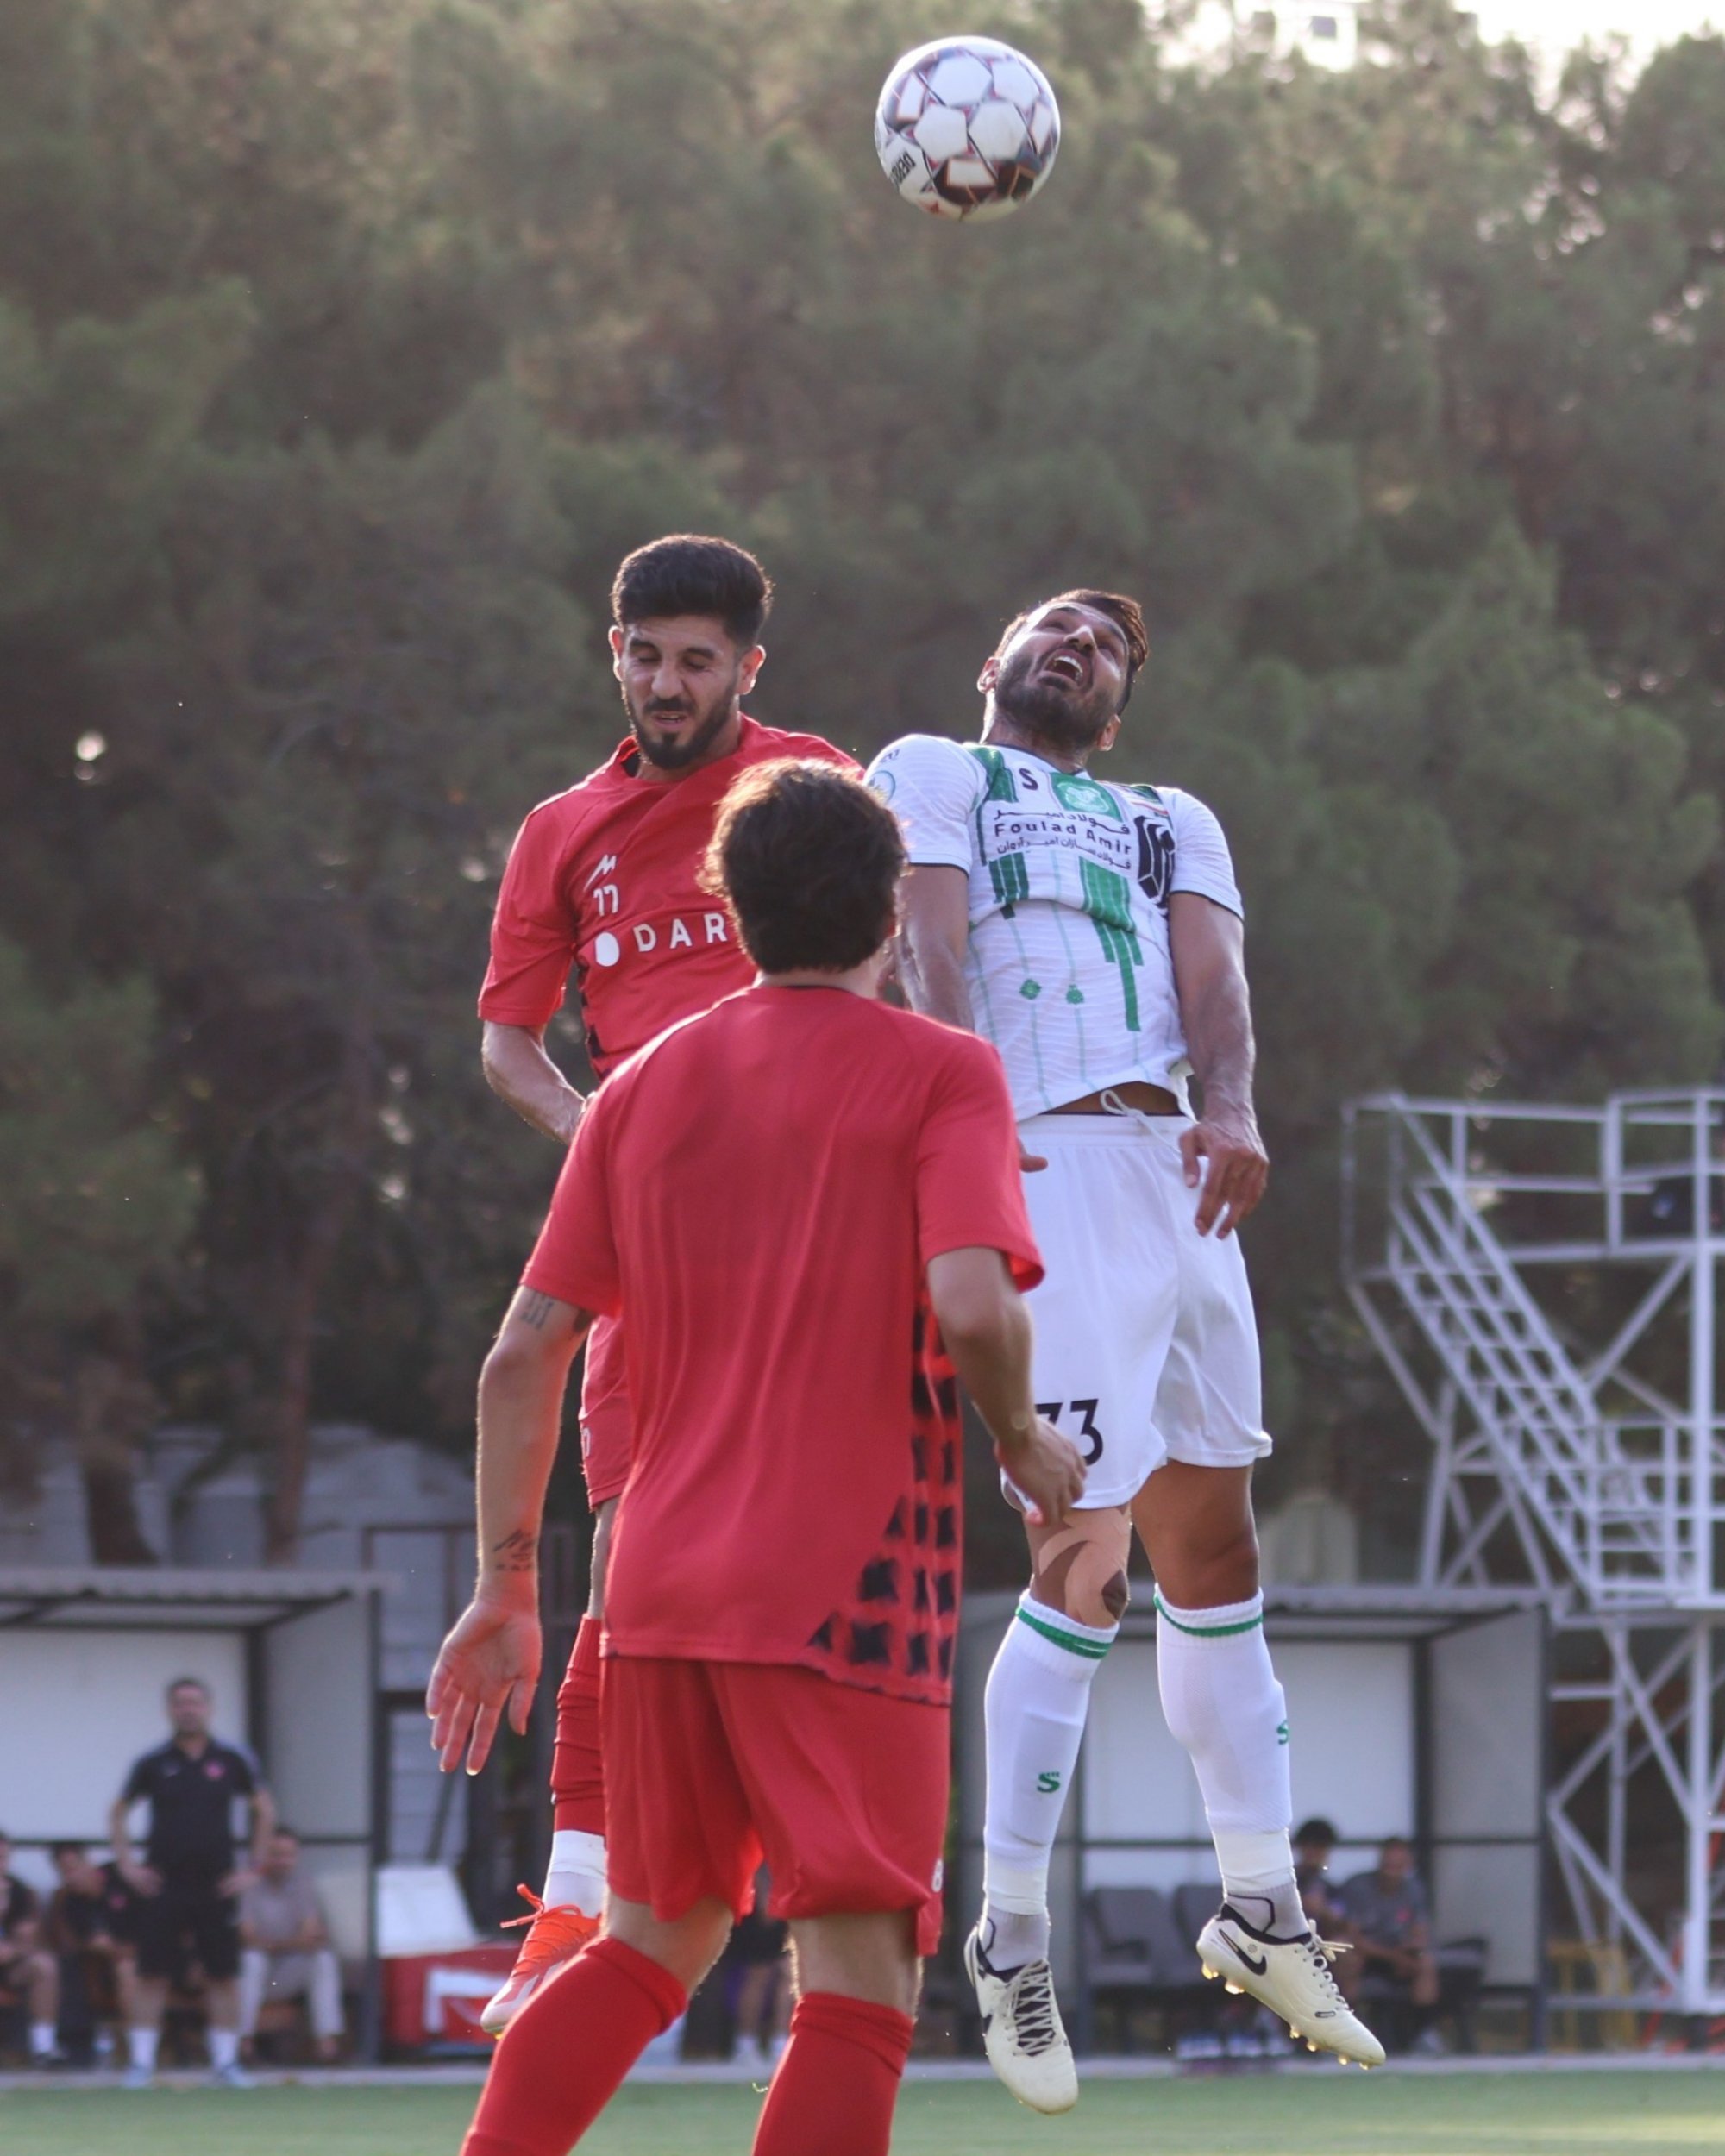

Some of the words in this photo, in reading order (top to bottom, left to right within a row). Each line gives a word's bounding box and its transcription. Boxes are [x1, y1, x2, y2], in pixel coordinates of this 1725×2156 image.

[994, 820, 1076, 837] Foulad
[1086, 829, 1132, 855] Amir
[632, 912, 728, 953] DAR
